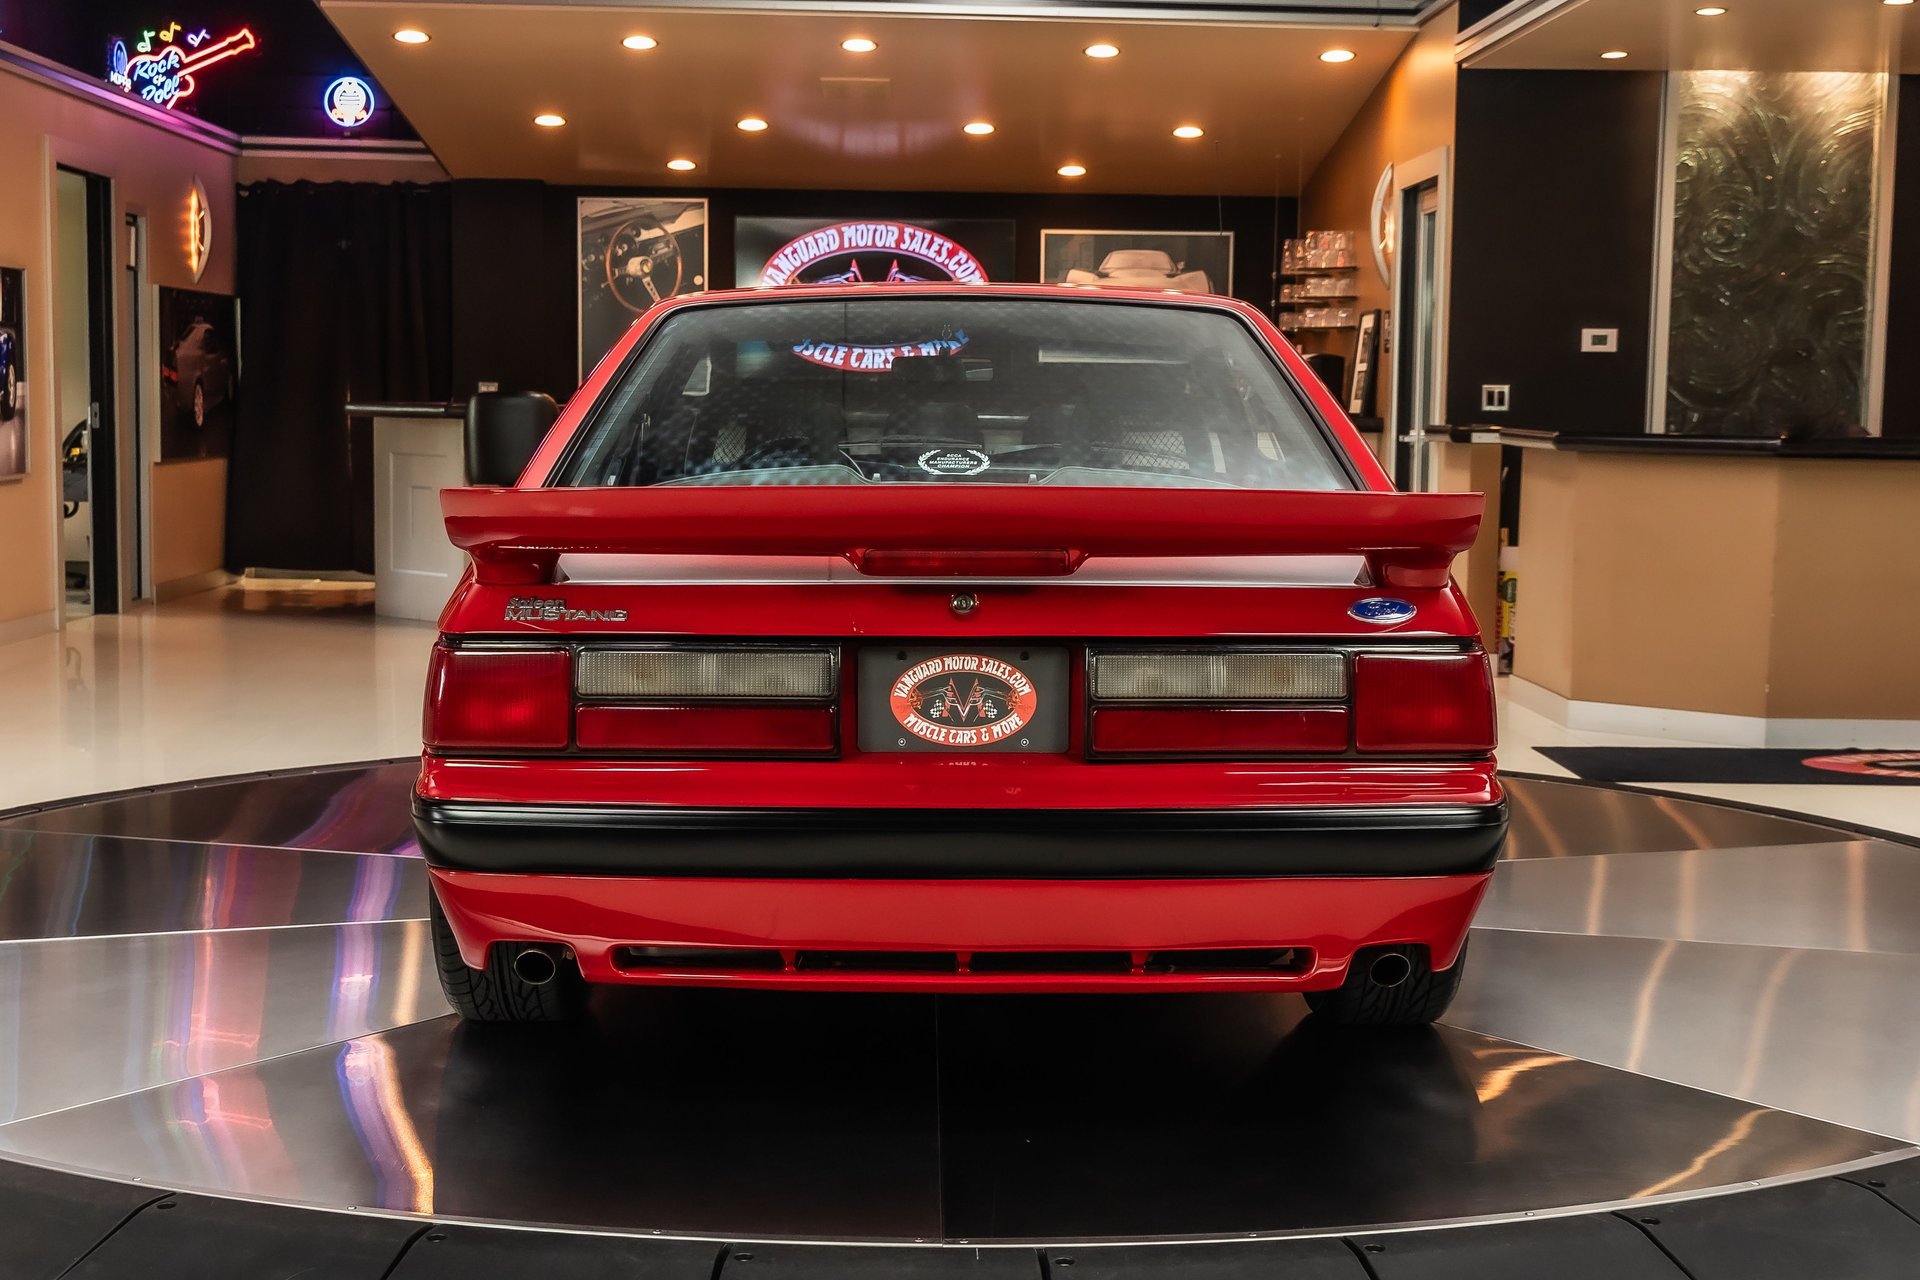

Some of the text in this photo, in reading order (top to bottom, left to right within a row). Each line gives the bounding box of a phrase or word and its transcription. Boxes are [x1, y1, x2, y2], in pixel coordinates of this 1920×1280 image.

[133, 50, 180, 81] Rock
[841, 224, 899, 249] MOTOR
[850, 348, 895, 369] CARS
[504, 608, 628, 622] MUSTANG
[893, 656, 1032, 698] VANGUARD MOTOR SALES.COM
[903, 712, 1024, 744] MUSCLE CARS & MORE
